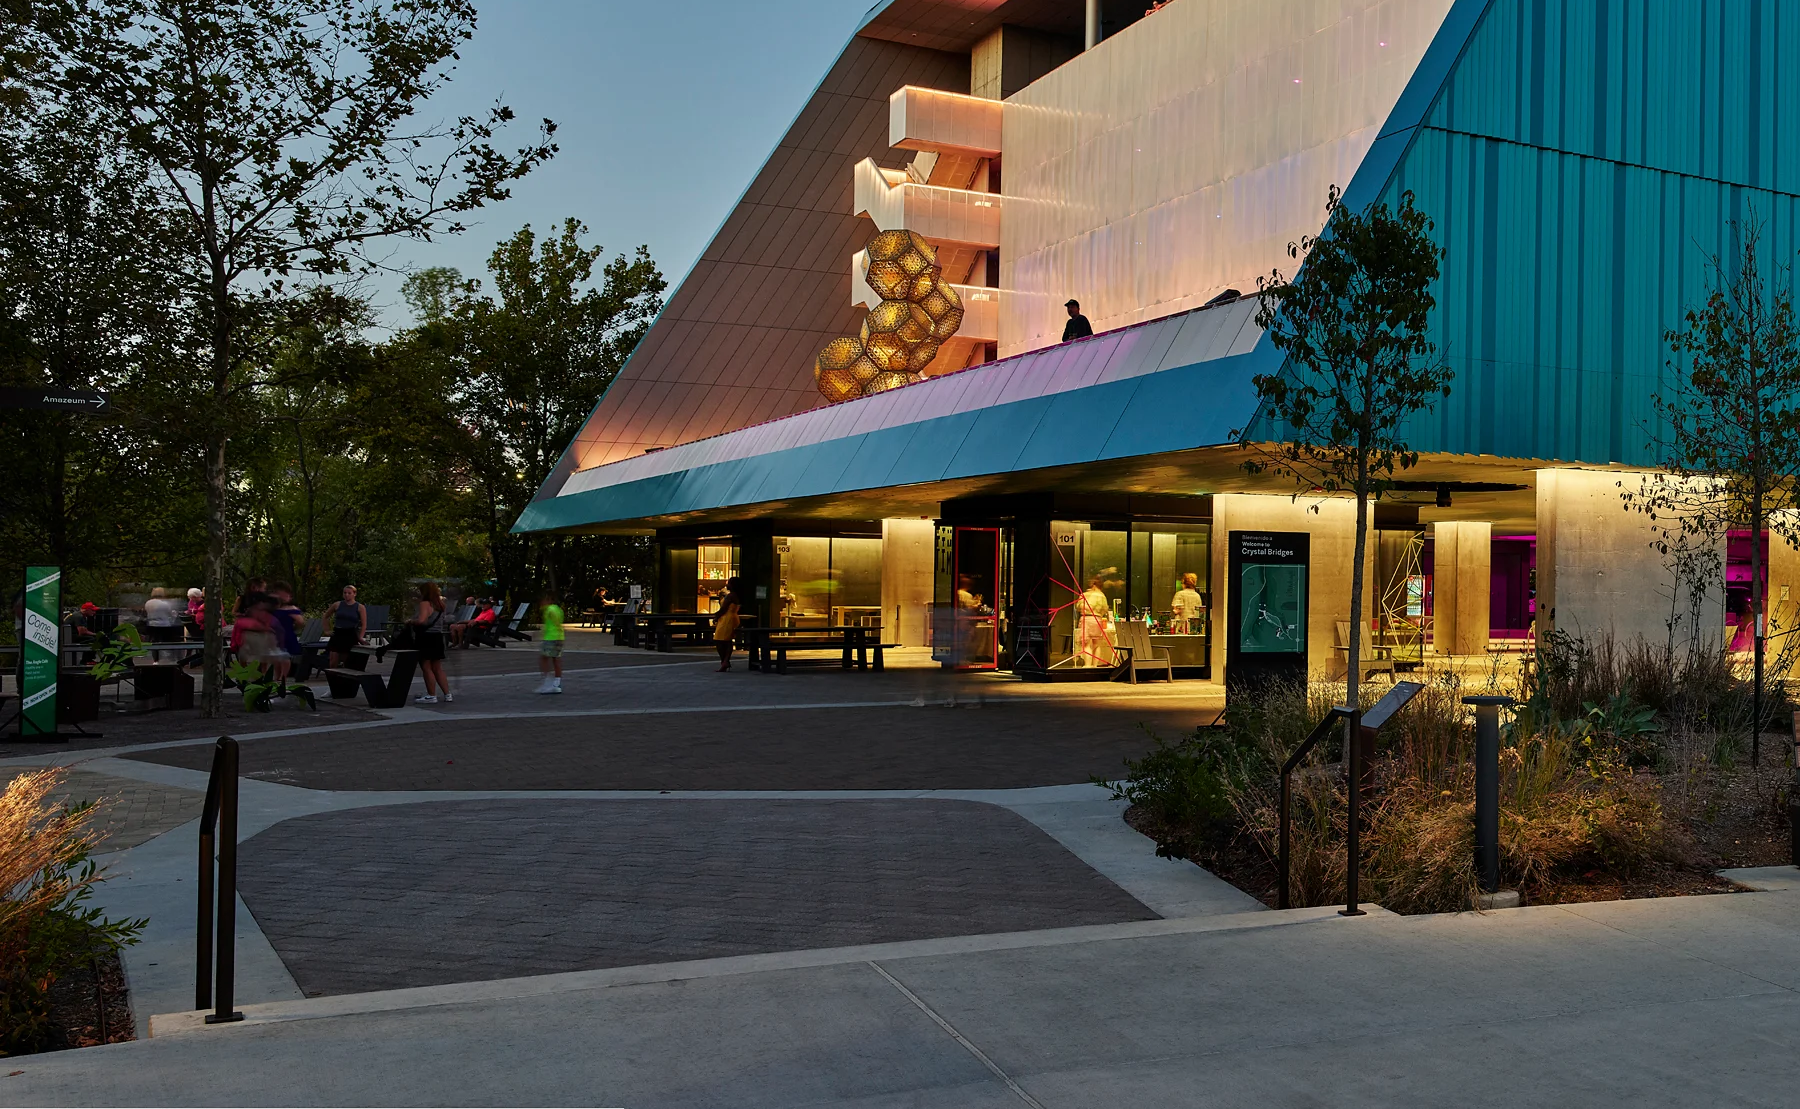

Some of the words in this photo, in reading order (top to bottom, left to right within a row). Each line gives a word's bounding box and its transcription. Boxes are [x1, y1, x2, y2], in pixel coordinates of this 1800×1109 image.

[42, 395, 86, 404] Amazeum
[1059, 535, 1074, 543] 101
[1241, 547, 1267, 556] Crystal
[1267, 548, 1294, 558] Bridges
[27, 614, 51, 634] Come
[32, 629, 57, 649] inside!
